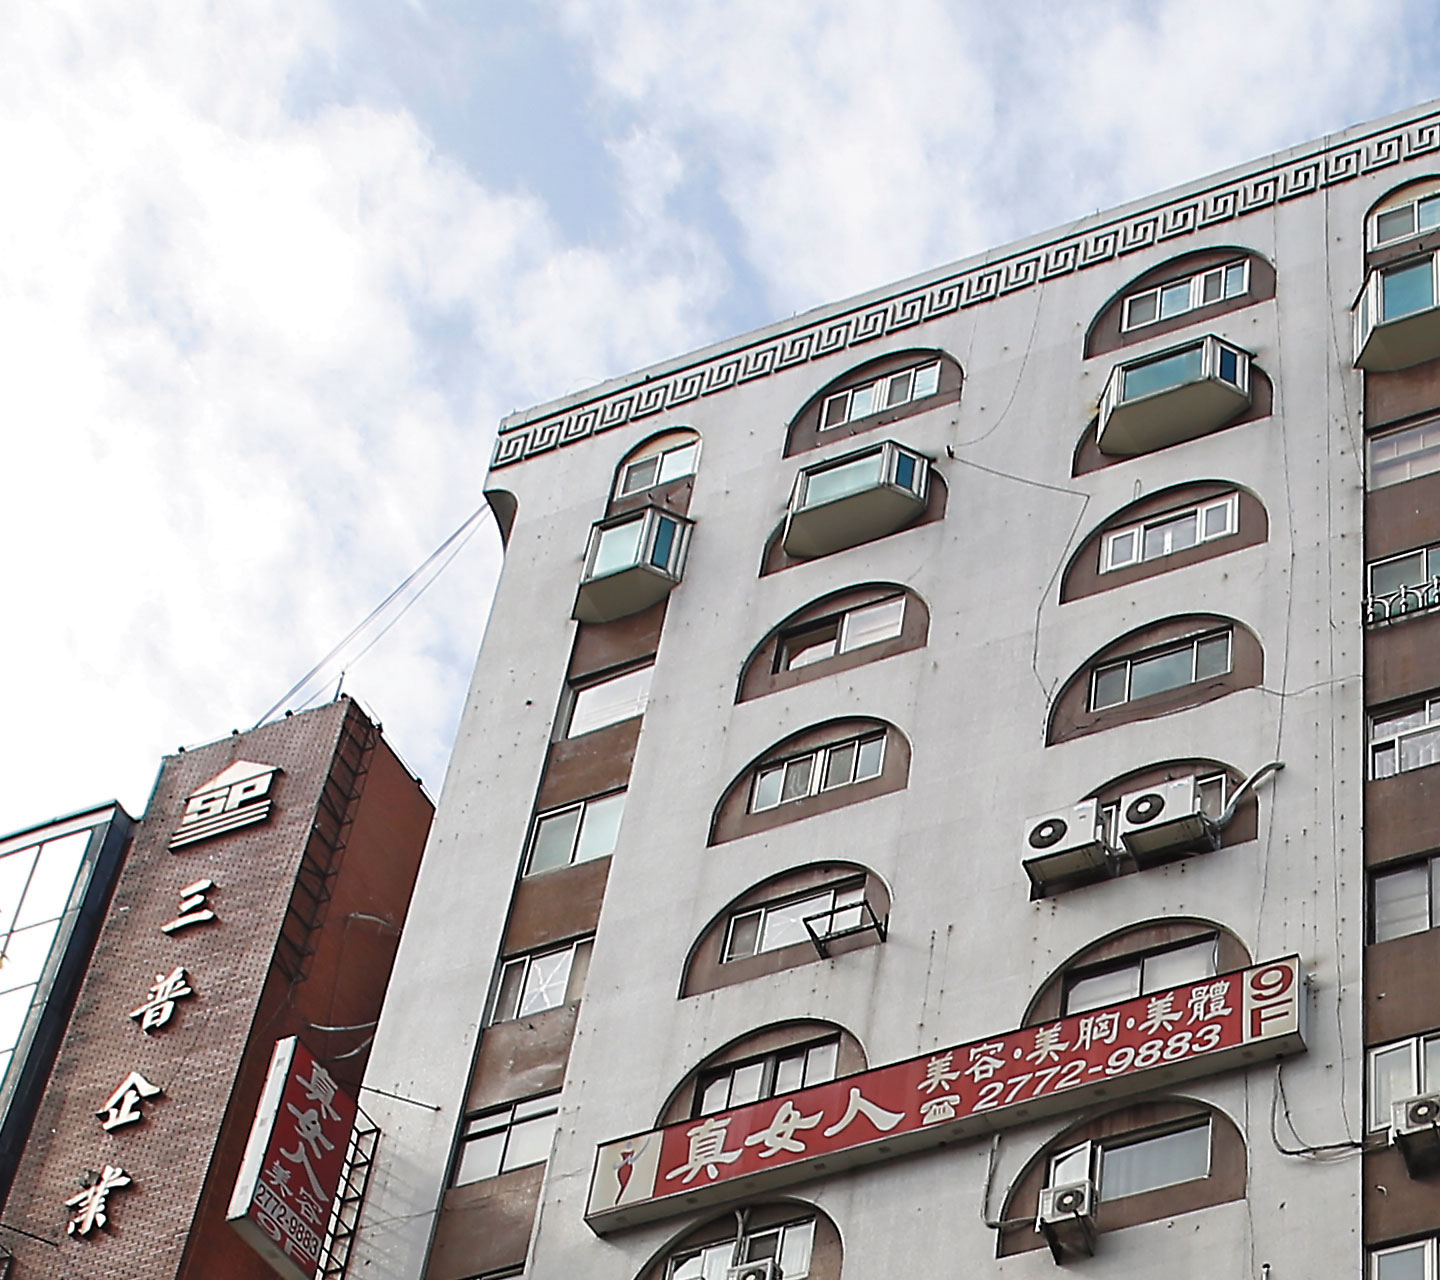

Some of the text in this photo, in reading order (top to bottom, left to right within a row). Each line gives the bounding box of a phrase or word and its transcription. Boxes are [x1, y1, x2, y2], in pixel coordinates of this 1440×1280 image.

[974, 1024, 1223, 1112] 2772-9883
[280, 1060, 347, 1205] 真女人
[666, 1086, 906, 1184] 真女人
